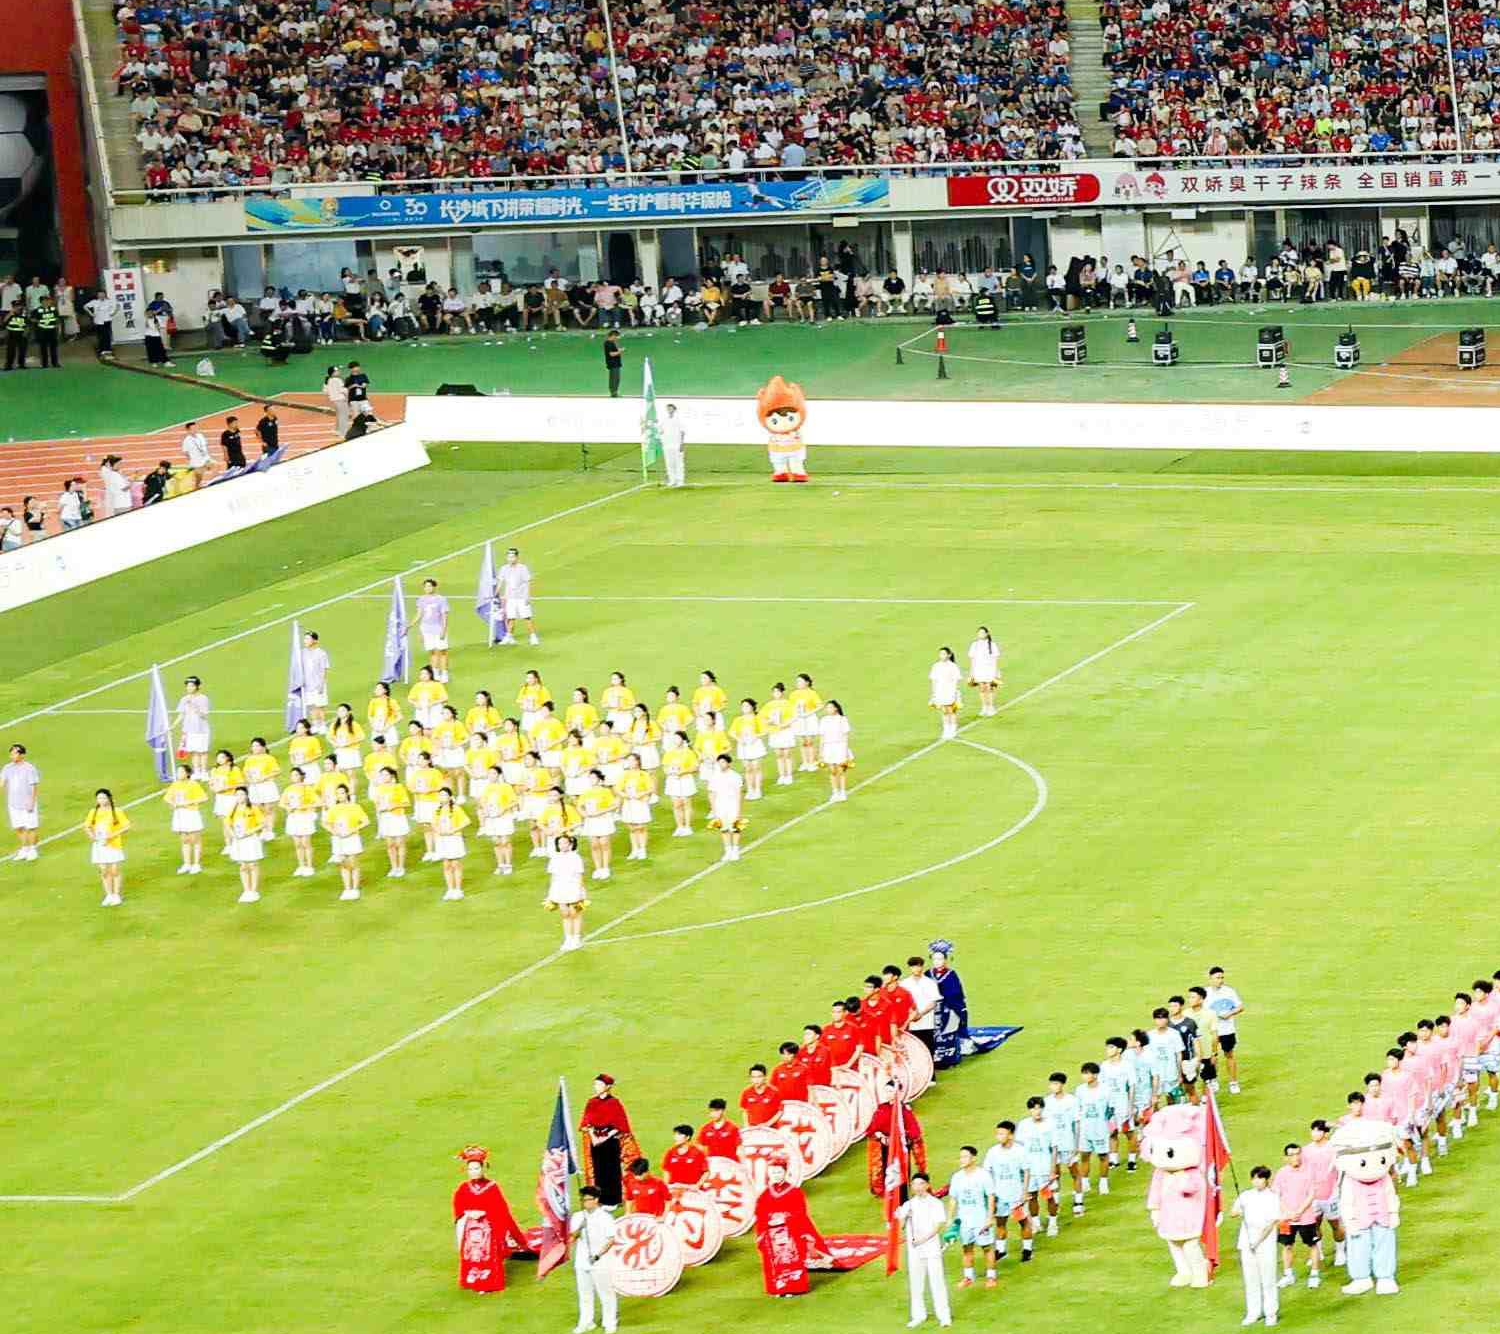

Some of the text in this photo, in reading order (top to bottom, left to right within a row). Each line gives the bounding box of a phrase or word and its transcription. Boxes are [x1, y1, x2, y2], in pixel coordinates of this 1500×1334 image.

[1019, 175, 1080, 198] 双娇
[1181, 172, 1342, 192] 双娇臭干子辣条
